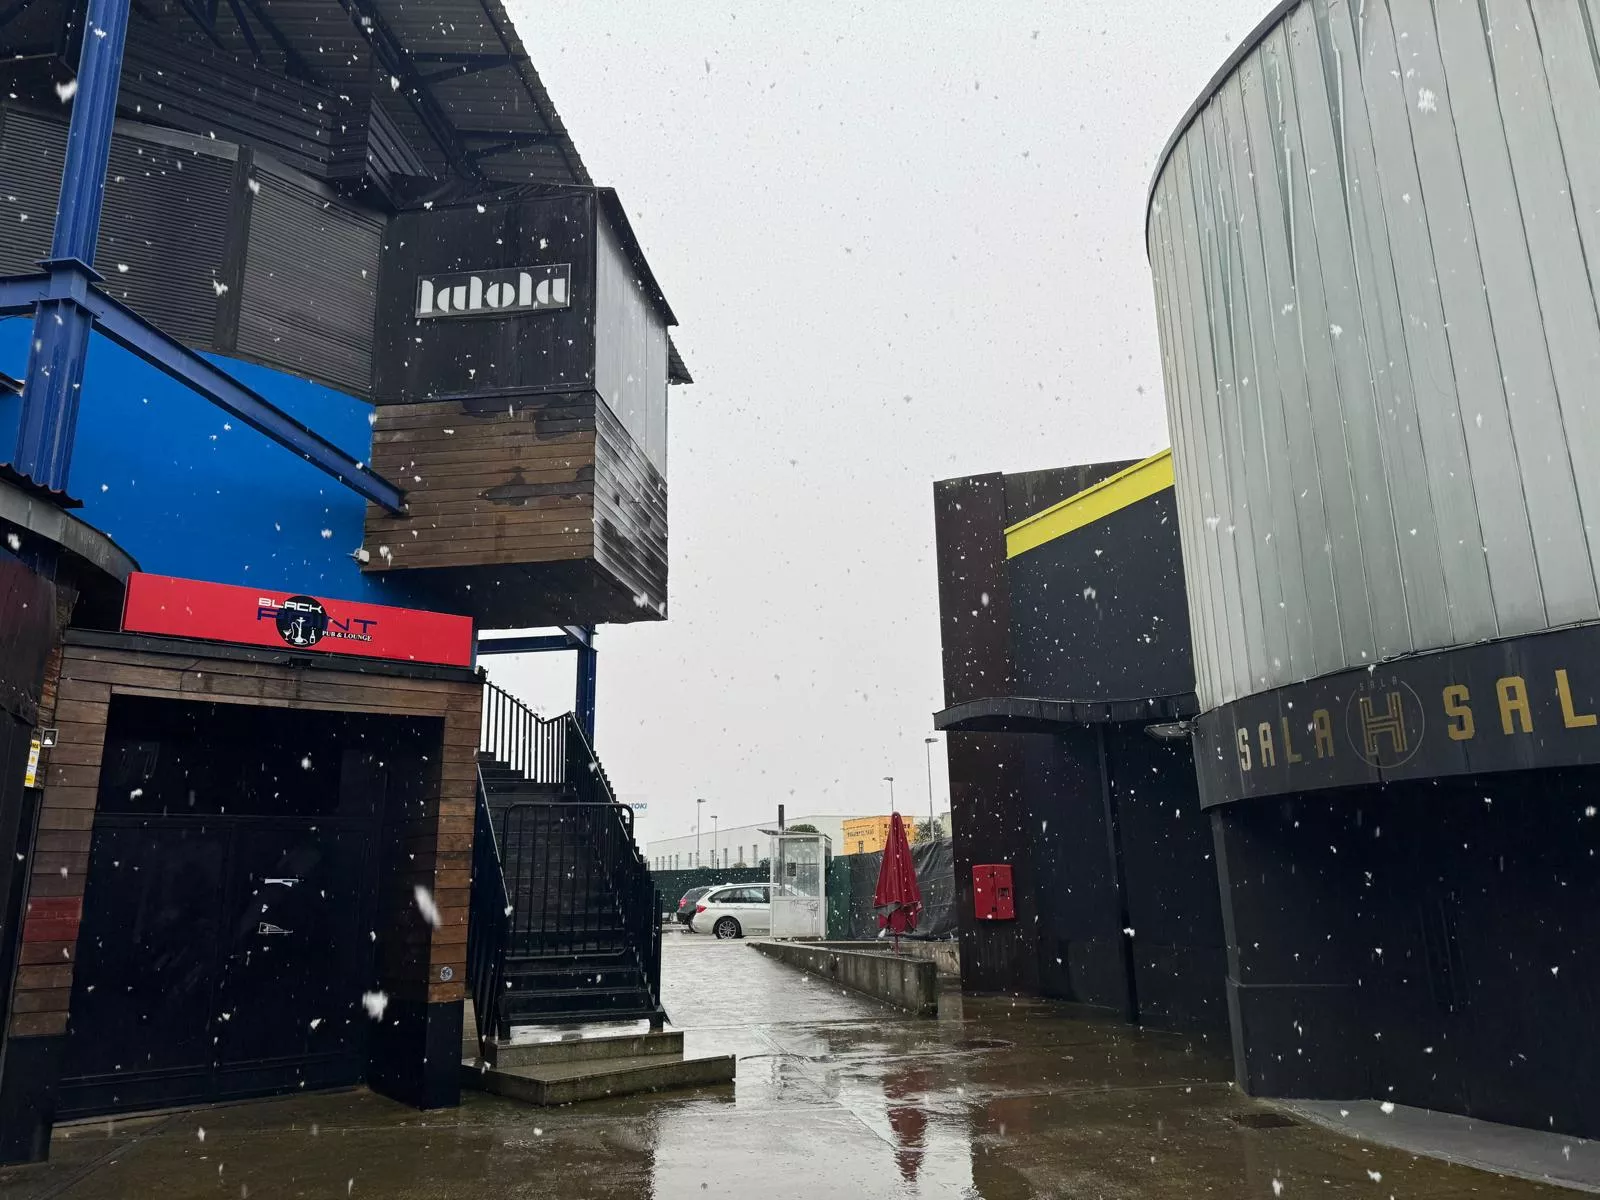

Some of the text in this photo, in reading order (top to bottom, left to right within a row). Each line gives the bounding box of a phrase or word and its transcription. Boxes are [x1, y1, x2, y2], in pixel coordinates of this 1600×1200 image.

[420, 272, 566, 313] lalola
[258, 597, 322, 613] BLACK
[321, 630, 336, 638] PUB
[343, 632, 373, 642] LOUNGE
[1359, 675, 1398, 692] SALA
[1237, 669, 1598, 771] SALA H SAL
